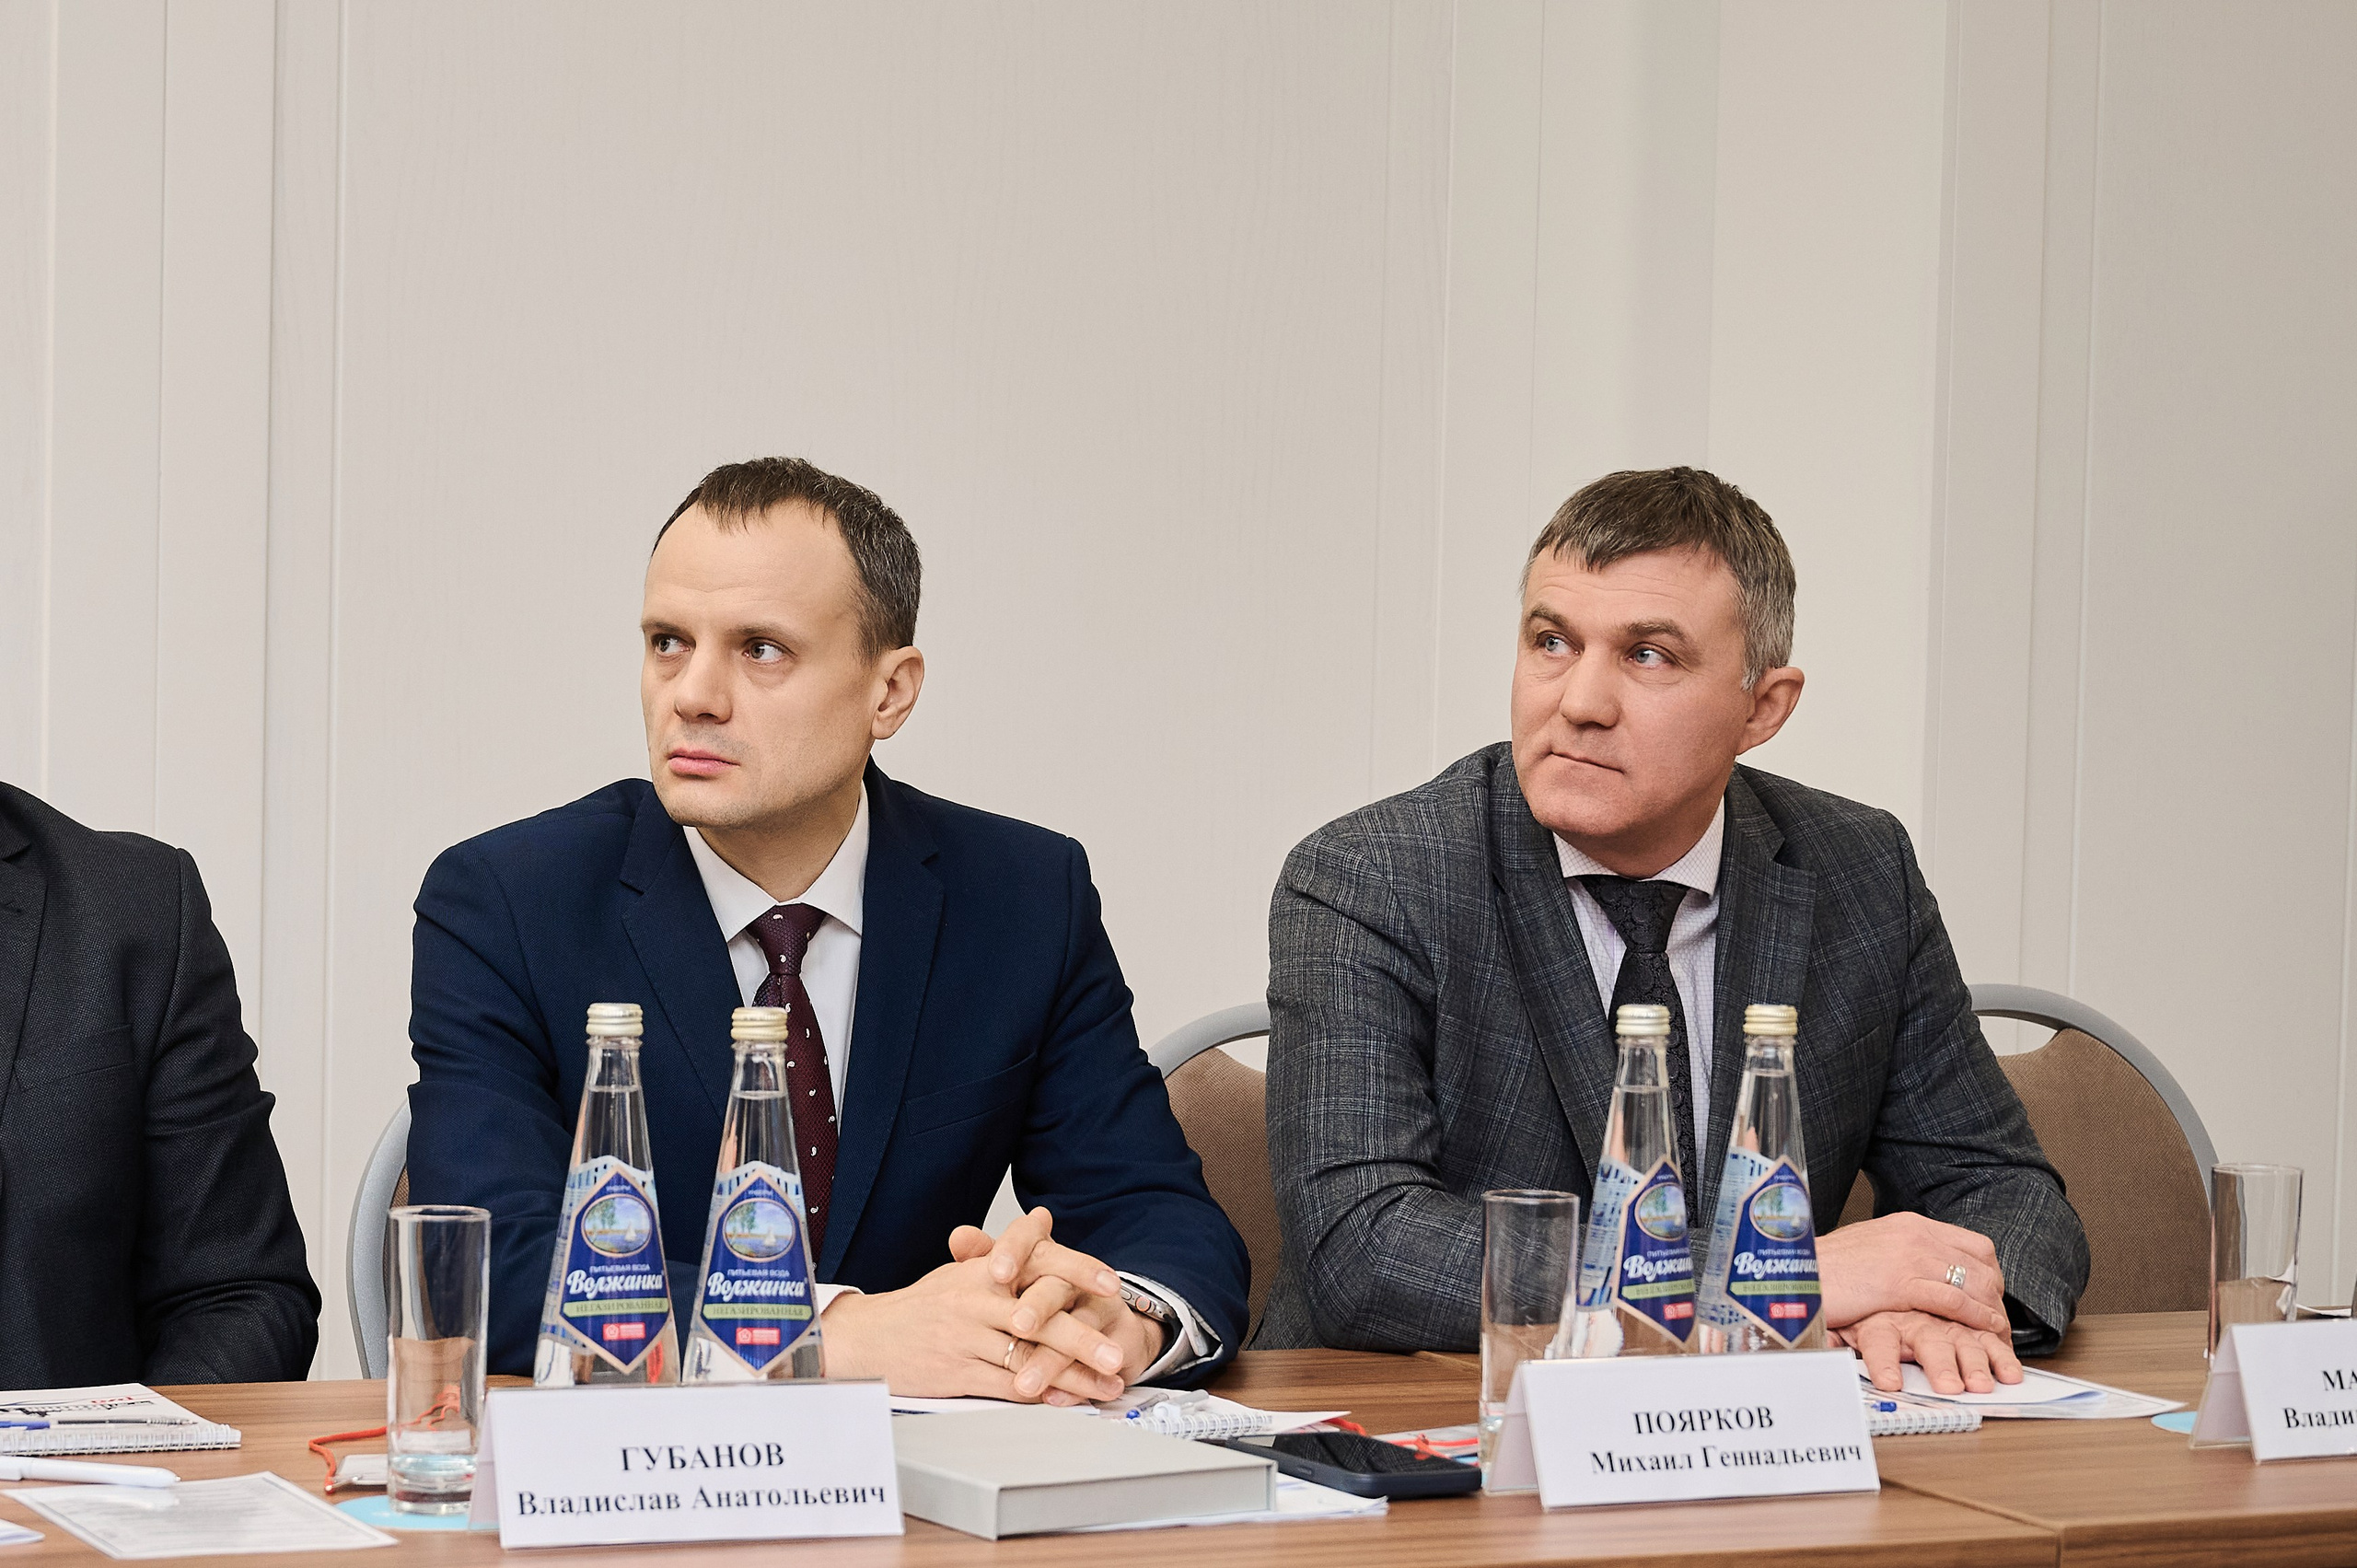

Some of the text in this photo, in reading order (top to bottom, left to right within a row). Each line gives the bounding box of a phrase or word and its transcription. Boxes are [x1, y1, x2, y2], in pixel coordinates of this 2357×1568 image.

[566, 1269, 663, 1299] Волжанка
[707, 1272, 806, 1303] Волжанка
[1632, 1406, 1775, 1434] ПОЯРКОВ
[2282, 1407, 2357, 1429] Влади
[620, 1442, 785, 1471] ГУБАНОВ
[1590, 1444, 1862, 1474] Михаил Геннадьевич
[517, 1485, 887, 1516] Владислав Анатольевич
